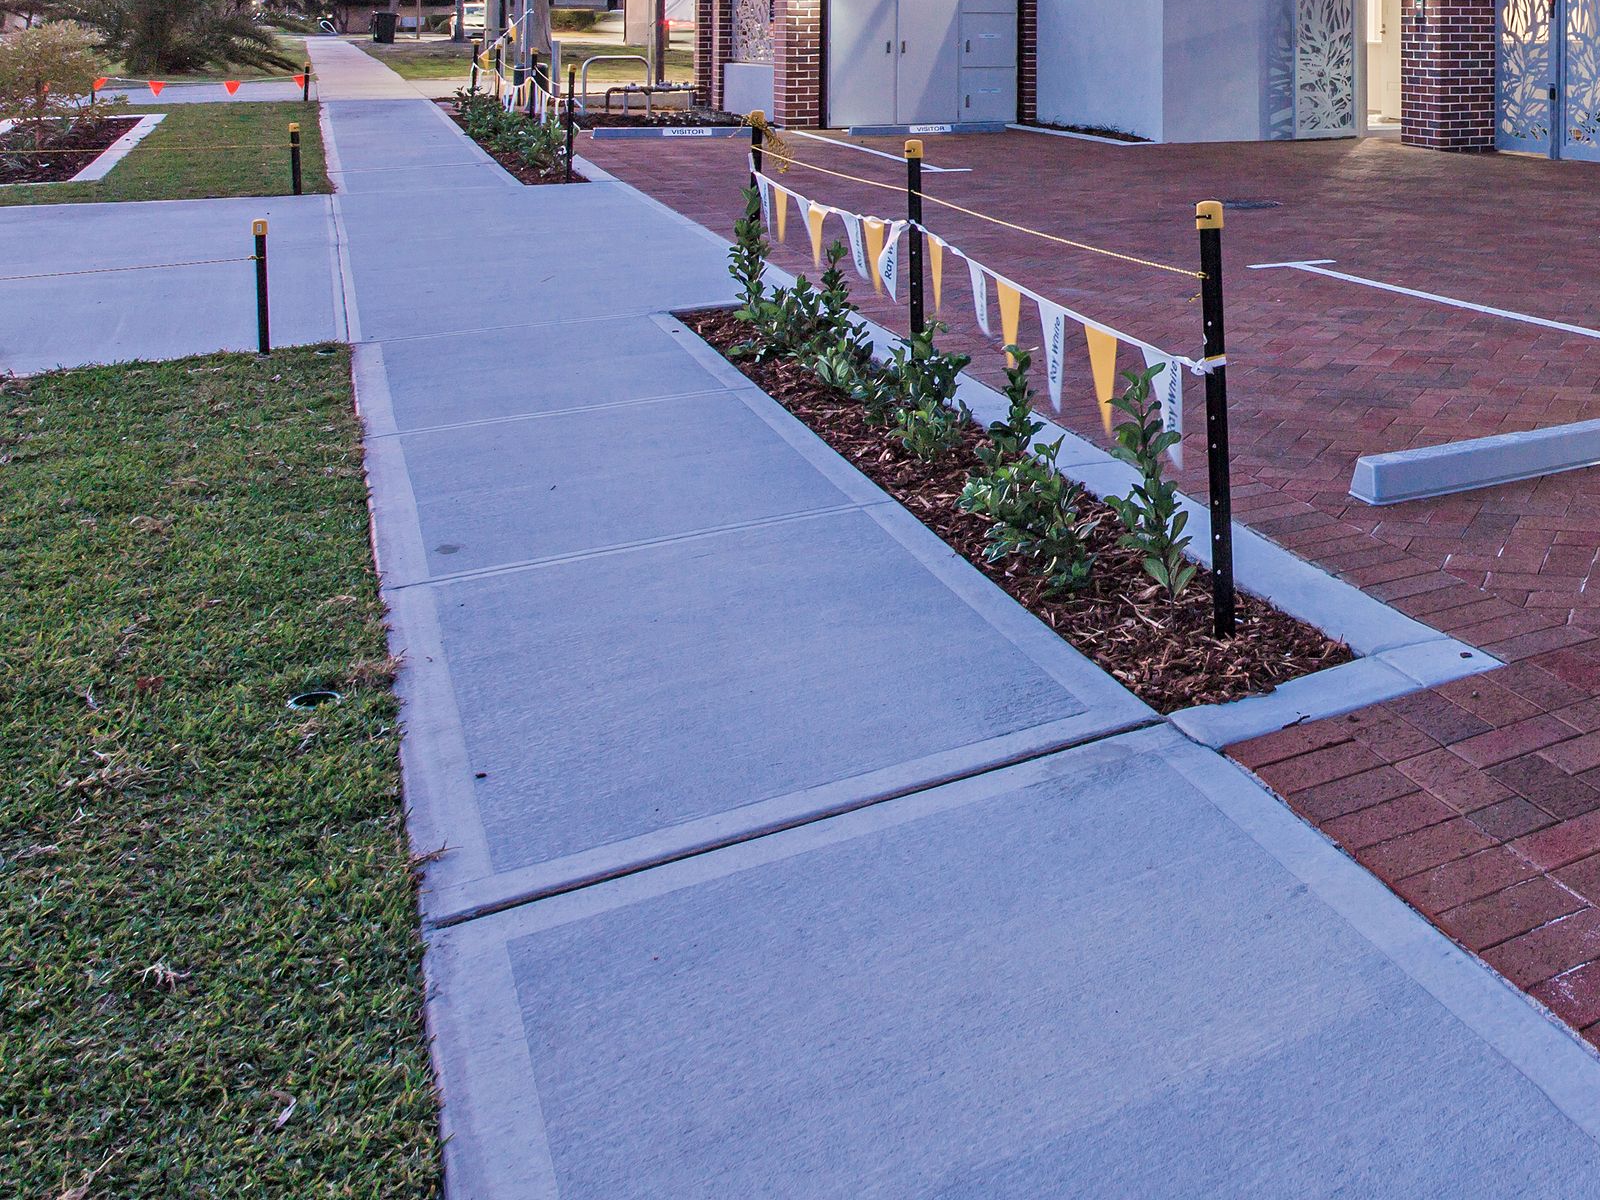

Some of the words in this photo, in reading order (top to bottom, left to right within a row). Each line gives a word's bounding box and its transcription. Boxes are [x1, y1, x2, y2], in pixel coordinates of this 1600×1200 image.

[670, 128, 706, 136] VISITOR
[884, 256, 895, 280] Ray
[1168, 361, 1179, 404] White
